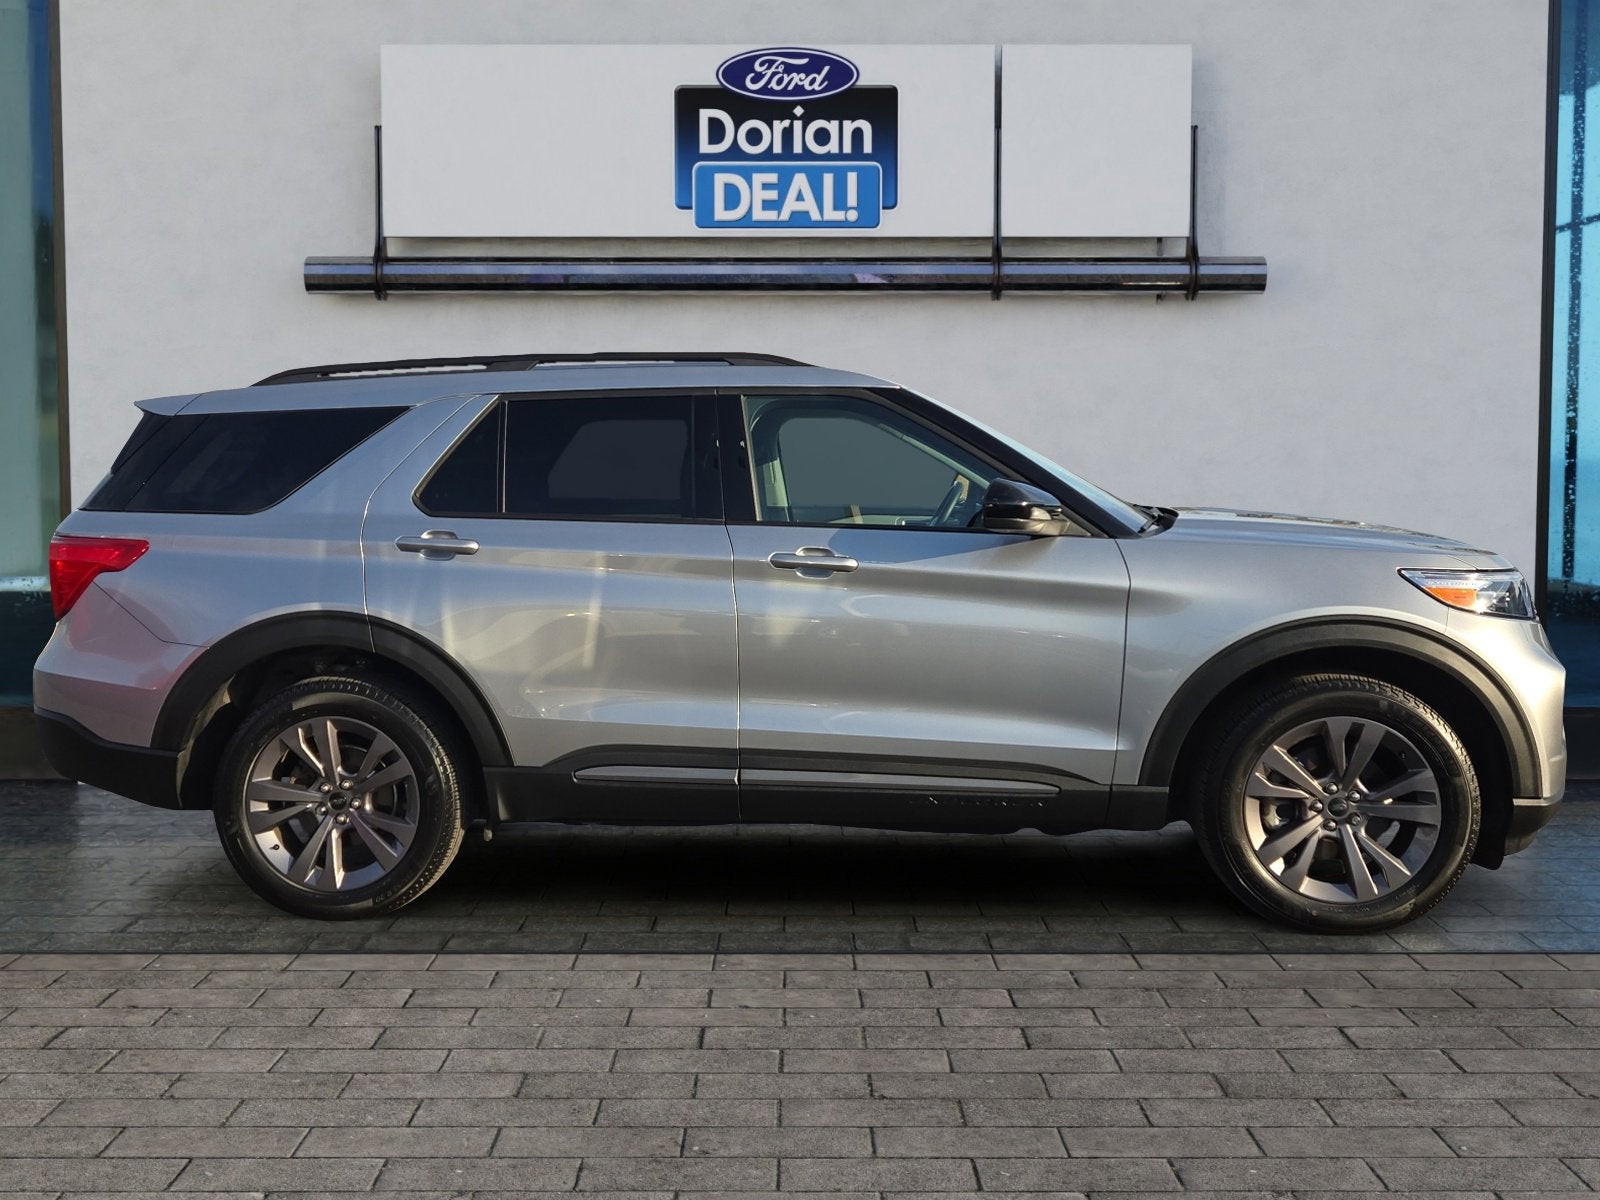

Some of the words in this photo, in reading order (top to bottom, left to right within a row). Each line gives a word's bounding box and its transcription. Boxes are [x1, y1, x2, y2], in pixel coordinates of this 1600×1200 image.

[745, 56, 831, 91] Ford
[699, 105, 873, 155] Dorian
[714, 171, 859, 222] DEAL!
